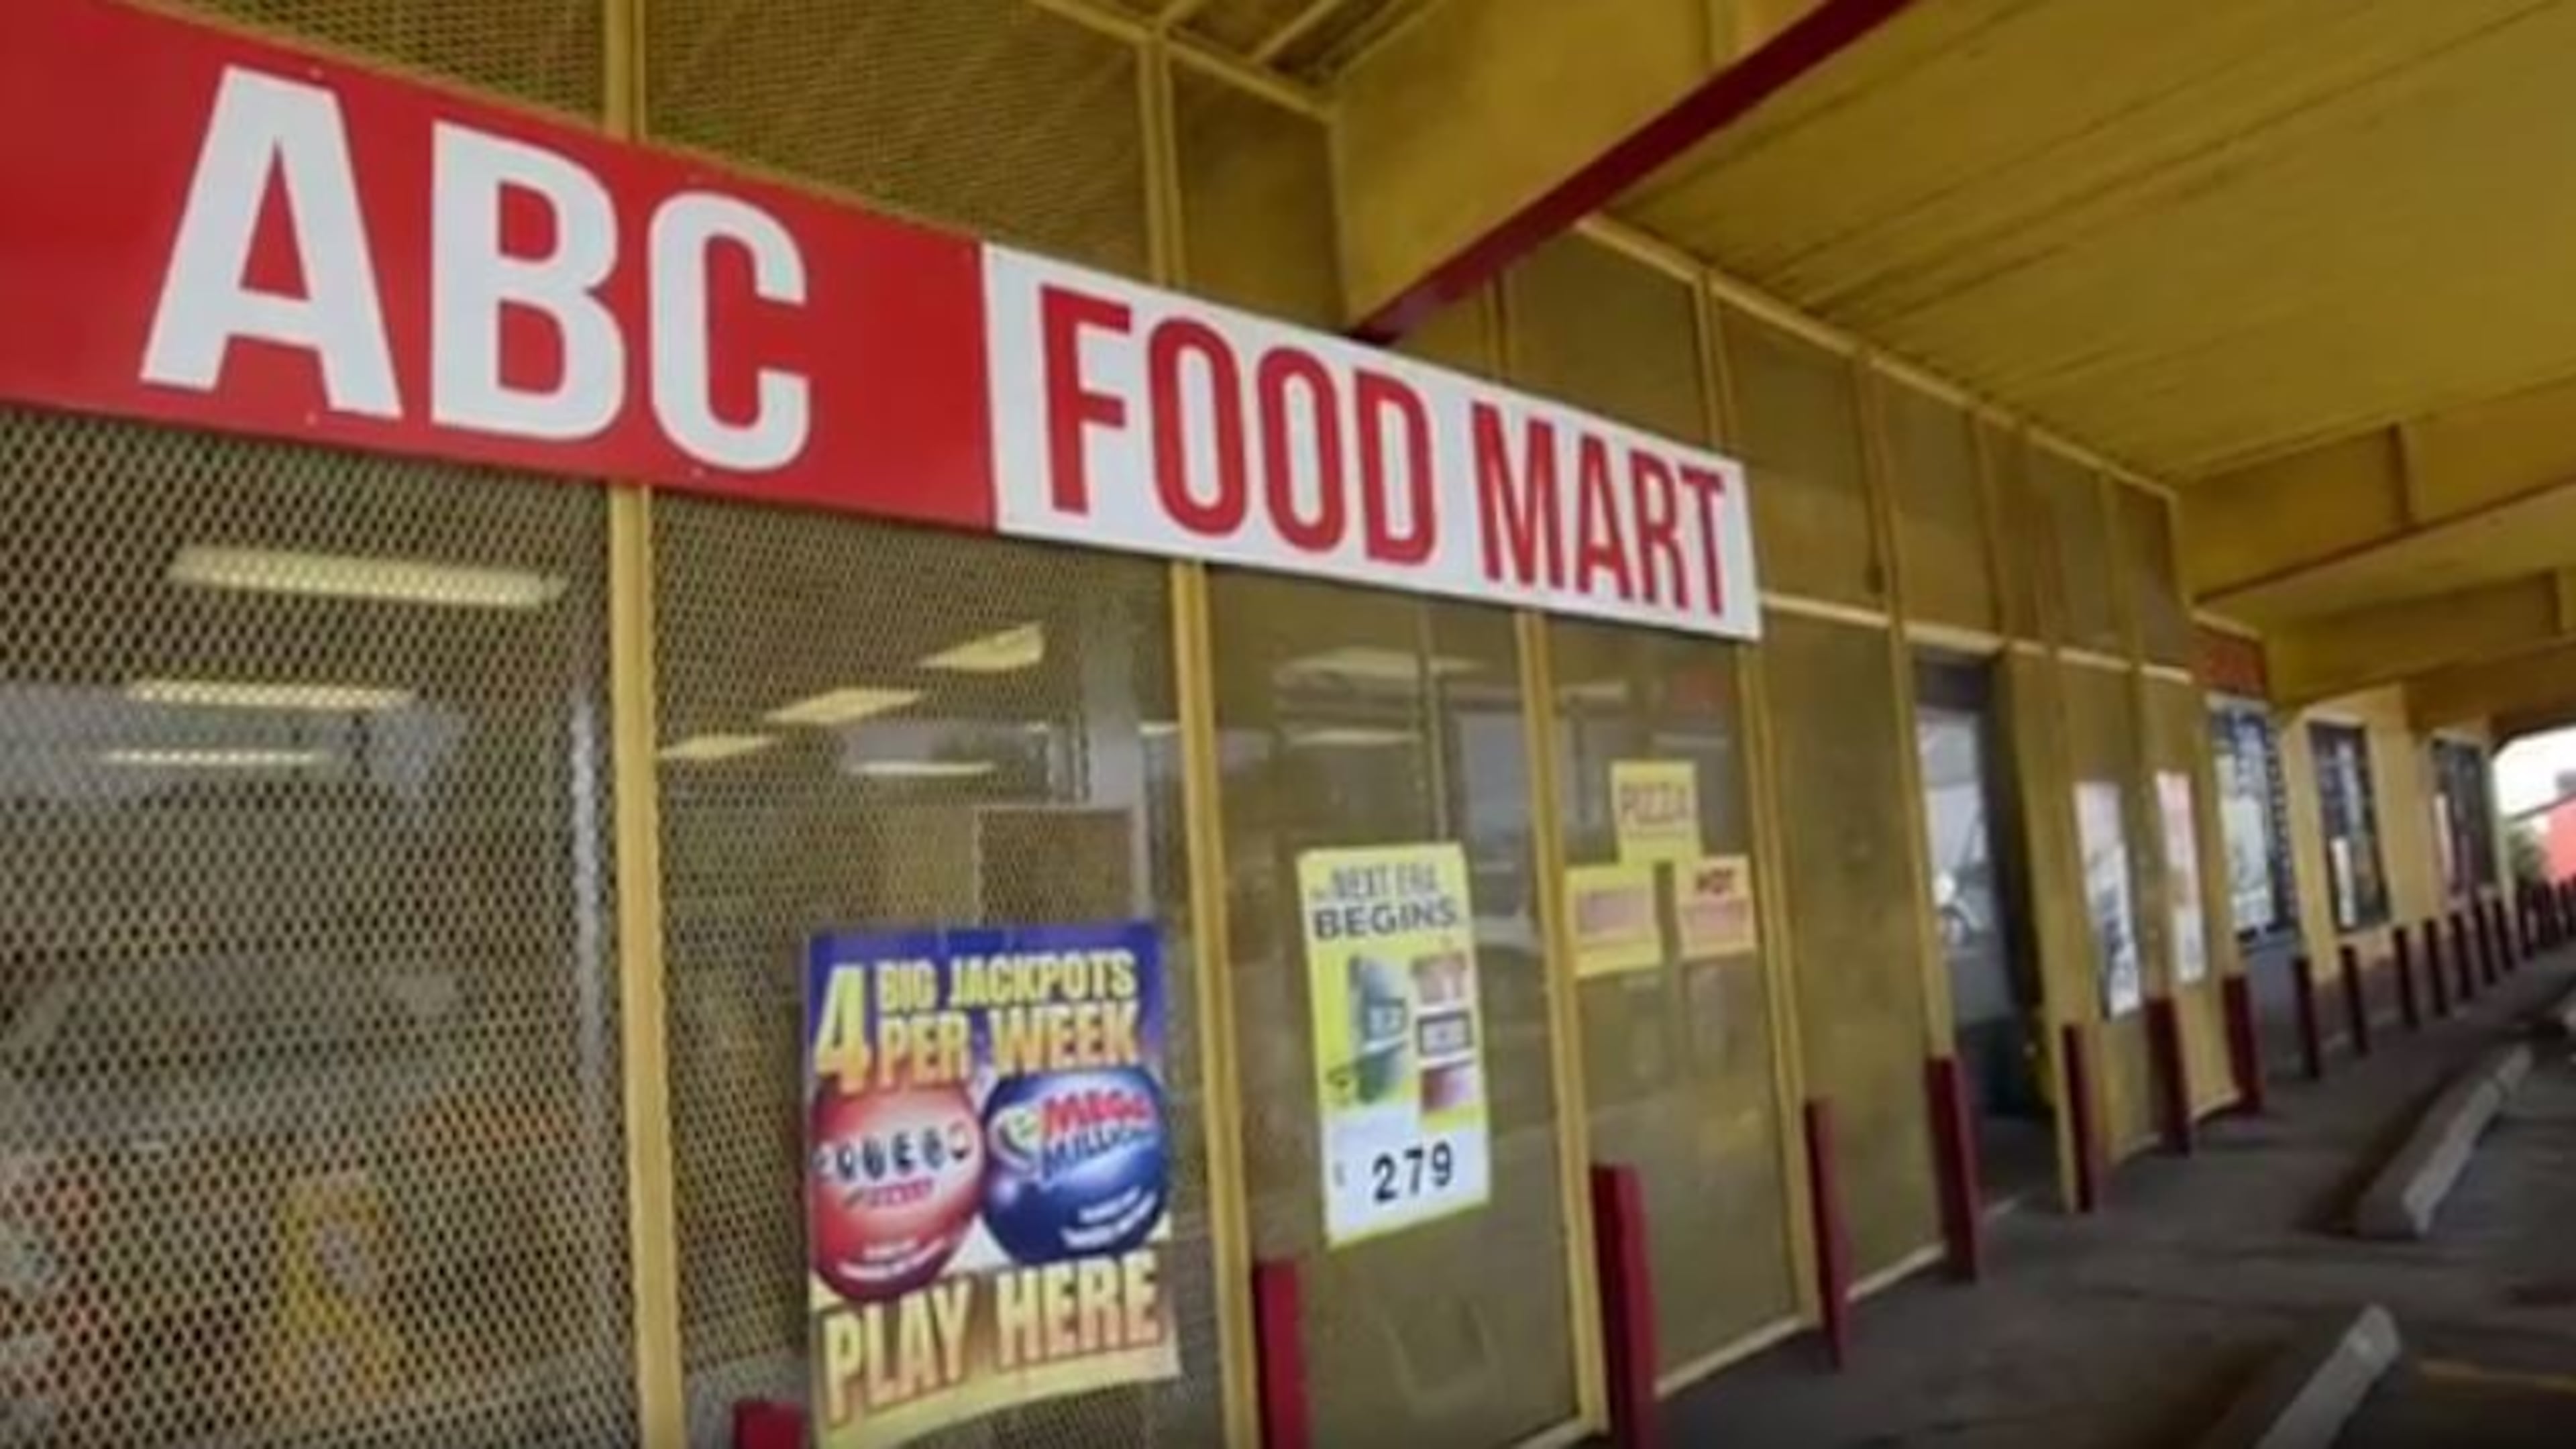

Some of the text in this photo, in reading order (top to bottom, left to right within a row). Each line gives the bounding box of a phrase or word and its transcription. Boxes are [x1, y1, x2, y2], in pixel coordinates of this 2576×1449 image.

[140, 65, 1726, 616] ABC FOOD MART
[1313, 896, 1458, 940] BEGINS
[875, 949, 1137, 1012] BIG JACKPOTS
[814, 964, 871, 1095] 4
[877, 998, 1139, 1088] PER WEEK
[1372, 1141, 1454, 1204] 279
[822, 1250, 1161, 1426] PLAY HERE
